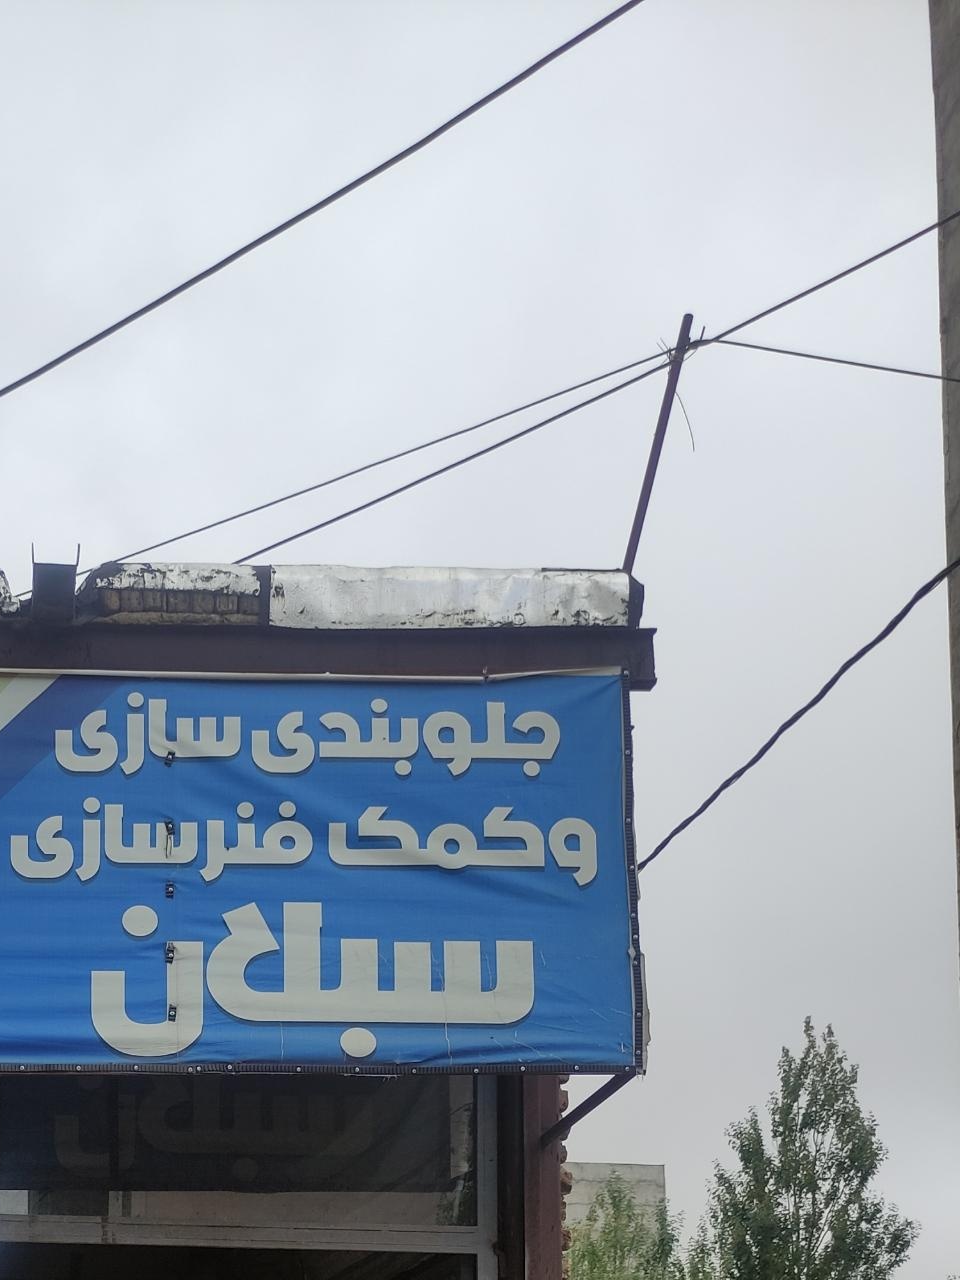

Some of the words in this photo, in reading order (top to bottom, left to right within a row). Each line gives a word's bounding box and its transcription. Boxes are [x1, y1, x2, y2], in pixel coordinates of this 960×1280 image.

[54, 692, 242, 775] سازی
[251, 698, 561, 776] جلوبندی
[90, 902, 536, 1057] سبلان
